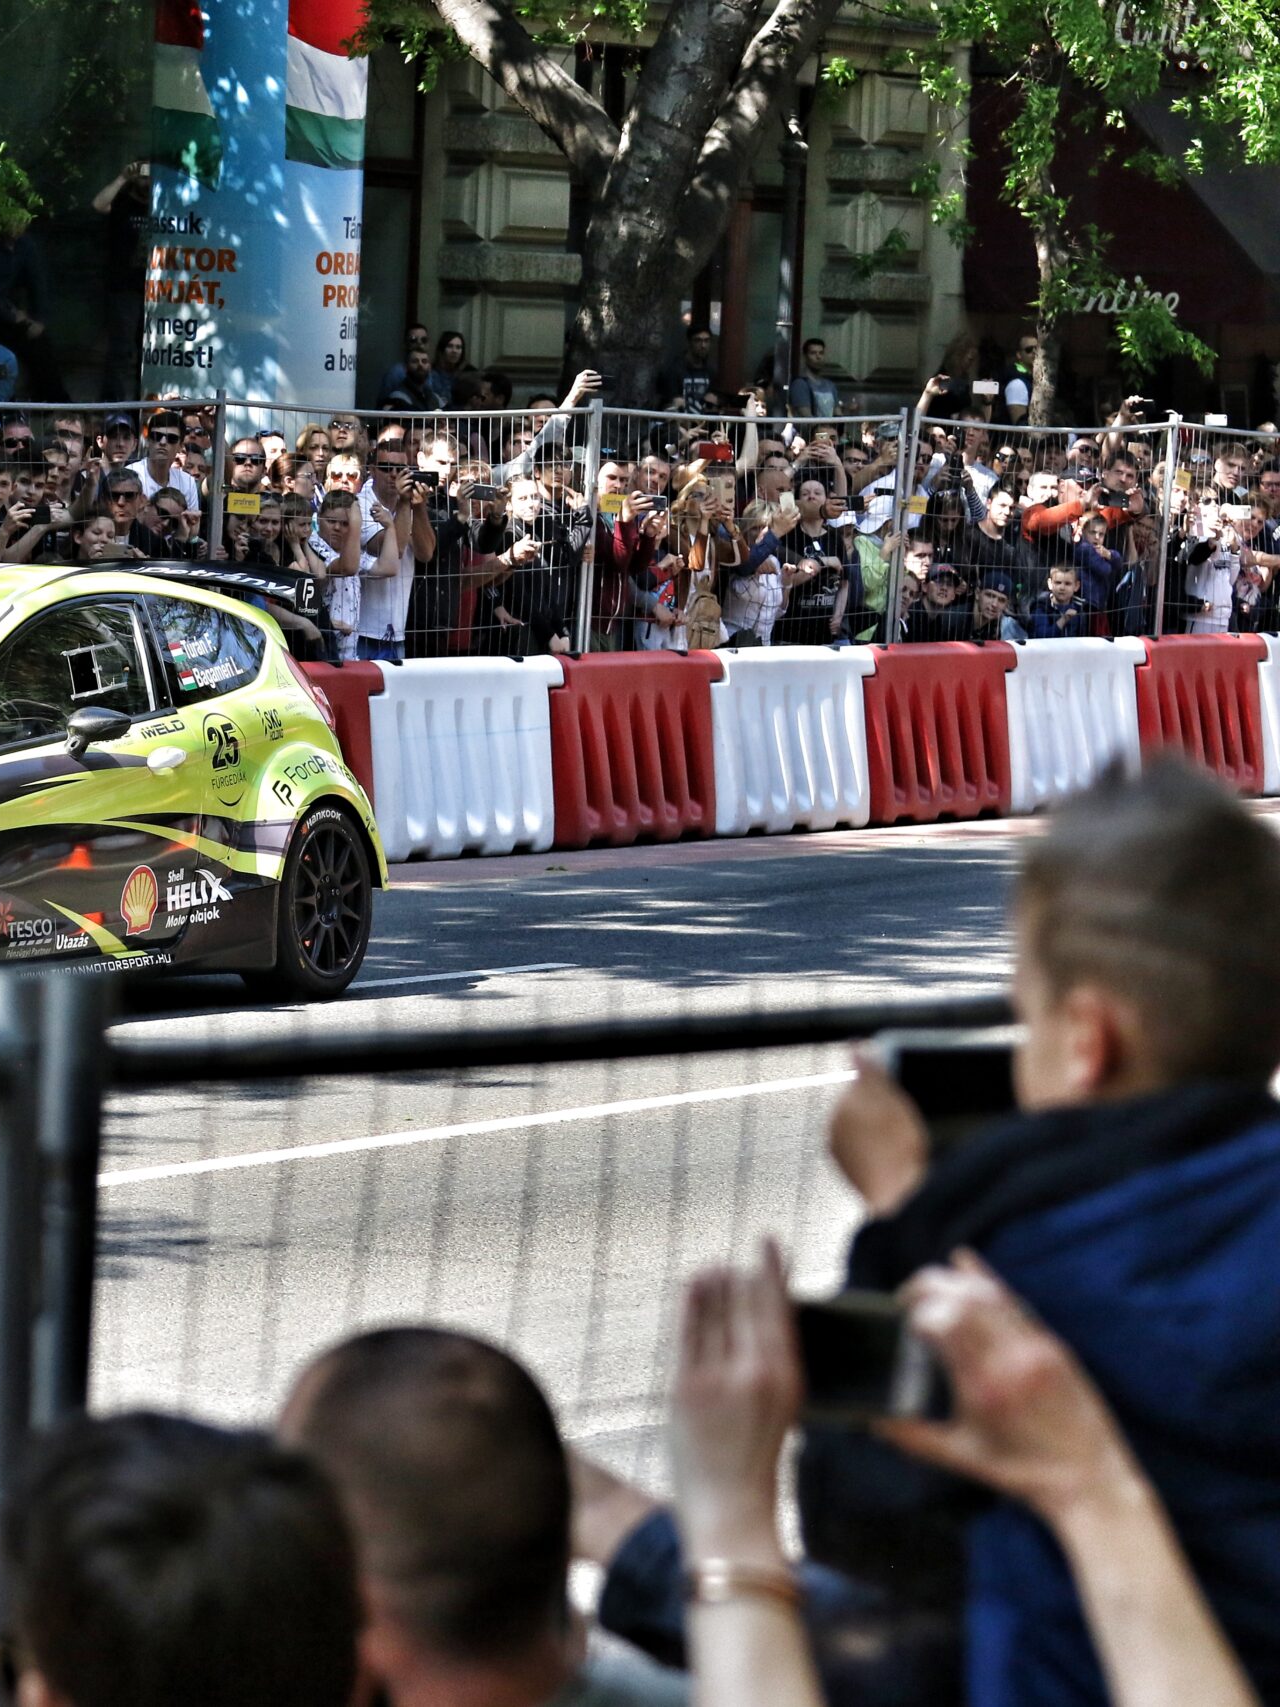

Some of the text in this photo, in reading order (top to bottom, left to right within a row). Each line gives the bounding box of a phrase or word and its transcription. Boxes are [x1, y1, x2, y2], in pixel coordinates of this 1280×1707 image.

[157, 317, 198, 341] meg
[324, 353, 335, 371] a
[207, 723, 241, 772] 25
[167, 867, 185, 884] Shell
[166, 868, 234, 913] HELIX
[7, 918, 53, 939] TESCO
[55, 932, 90, 951] Utazás
